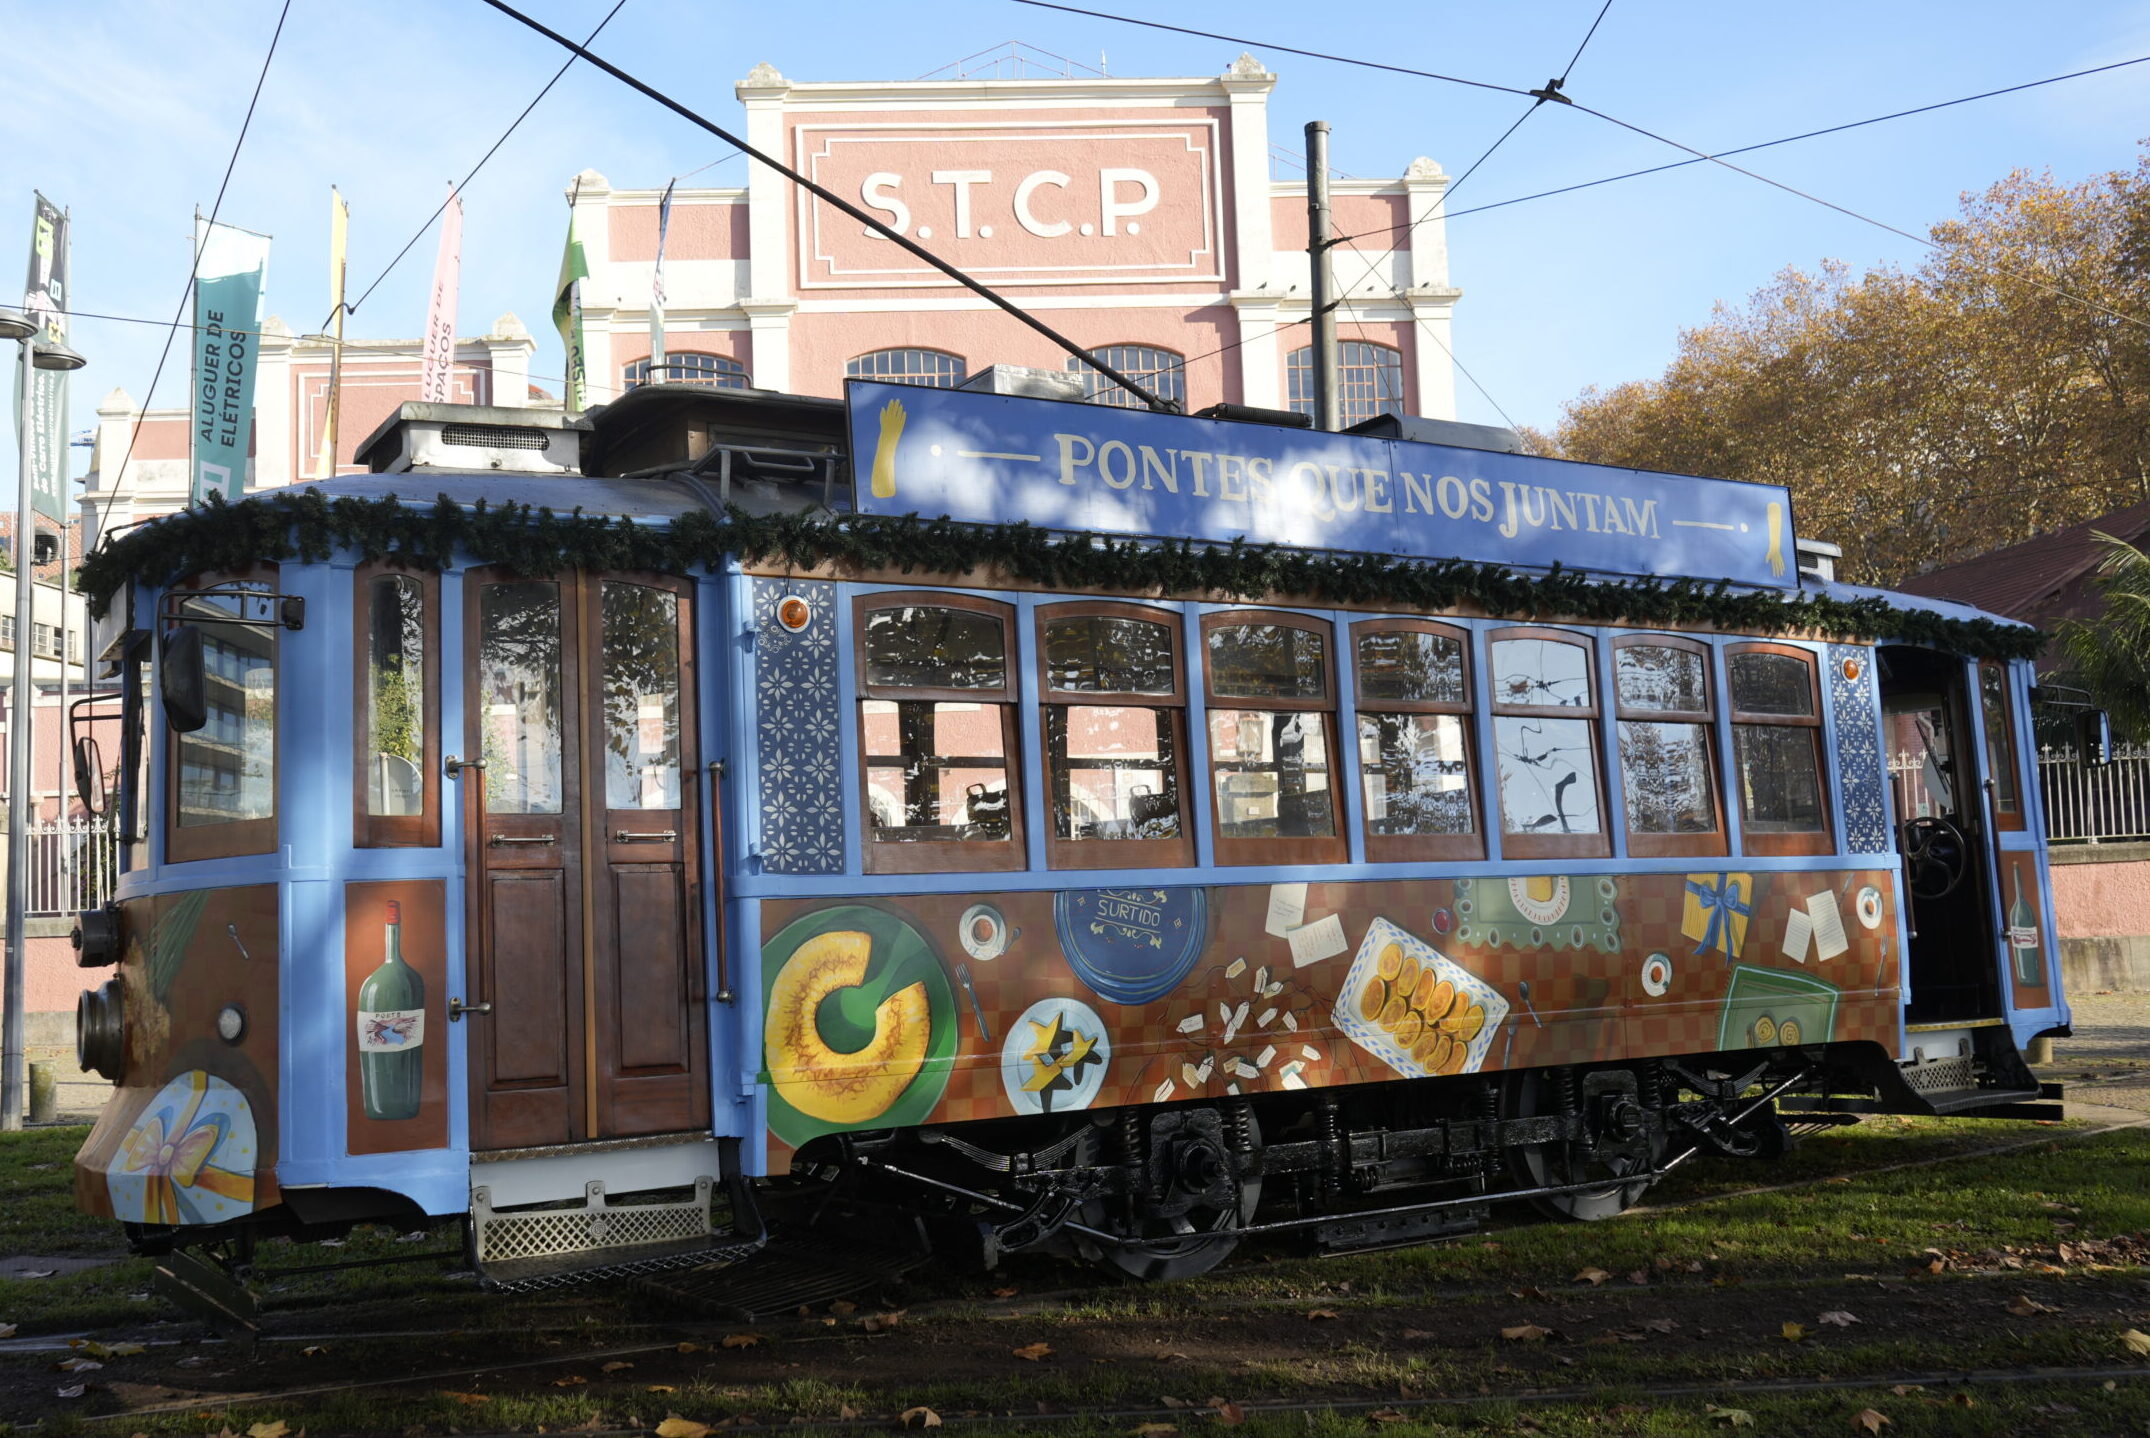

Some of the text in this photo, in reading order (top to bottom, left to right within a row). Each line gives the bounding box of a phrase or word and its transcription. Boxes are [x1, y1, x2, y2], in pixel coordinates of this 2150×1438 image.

[201, 309, 224, 443] ALUGUER DE
[424, 281, 443, 400] LUGUER DE
[434, 322, 452, 403] SPAÇOS
[219, 331, 247, 448] ELÉTRICOS
[39, 435, 47, 472] Carro
[41, 477, 48, 494] do
[1054, 433, 1661, 540] PONTES QUE NOS JUNTAM
[1097, 899, 1161, 927] SURTIDO
